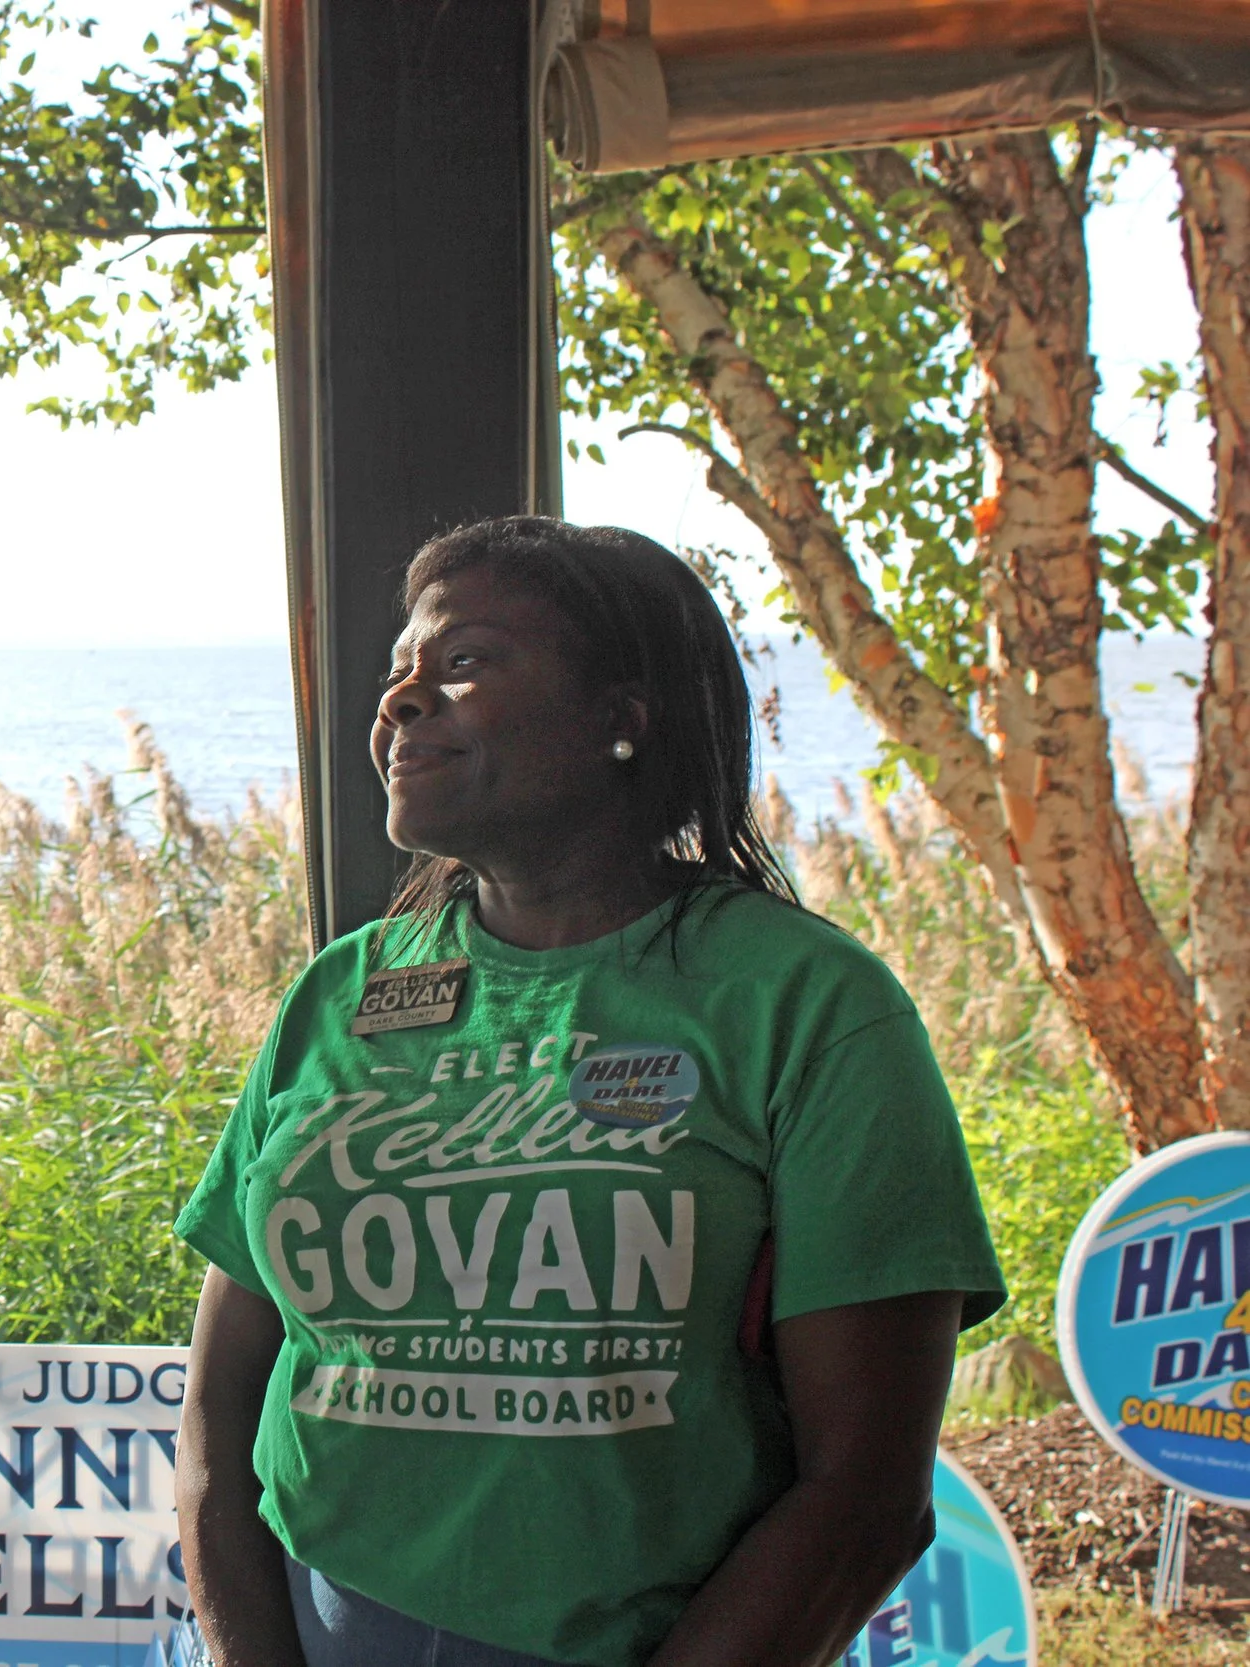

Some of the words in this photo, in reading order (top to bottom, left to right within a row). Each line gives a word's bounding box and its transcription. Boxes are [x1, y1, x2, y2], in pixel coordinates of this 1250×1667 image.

[362, 981, 458, 1014] GOVAN
[369, 1016, 395, 1026] DARE
[398, 1010, 437, 1022] COUNTY
[431, 1031, 598, 1083] ELECT
[583, 1054, 683, 1082] HAVEL
[592, 1084, 667, 1099] DARE
[265, 1188, 695, 1313] GOVAN
[407, 1336, 568, 1365] STUDENTS
[584, 1338, 682, 1364] FIRST!
[326, 1376, 477, 1420] SCHOOL
[494, 1385, 635, 1424] BOARD
